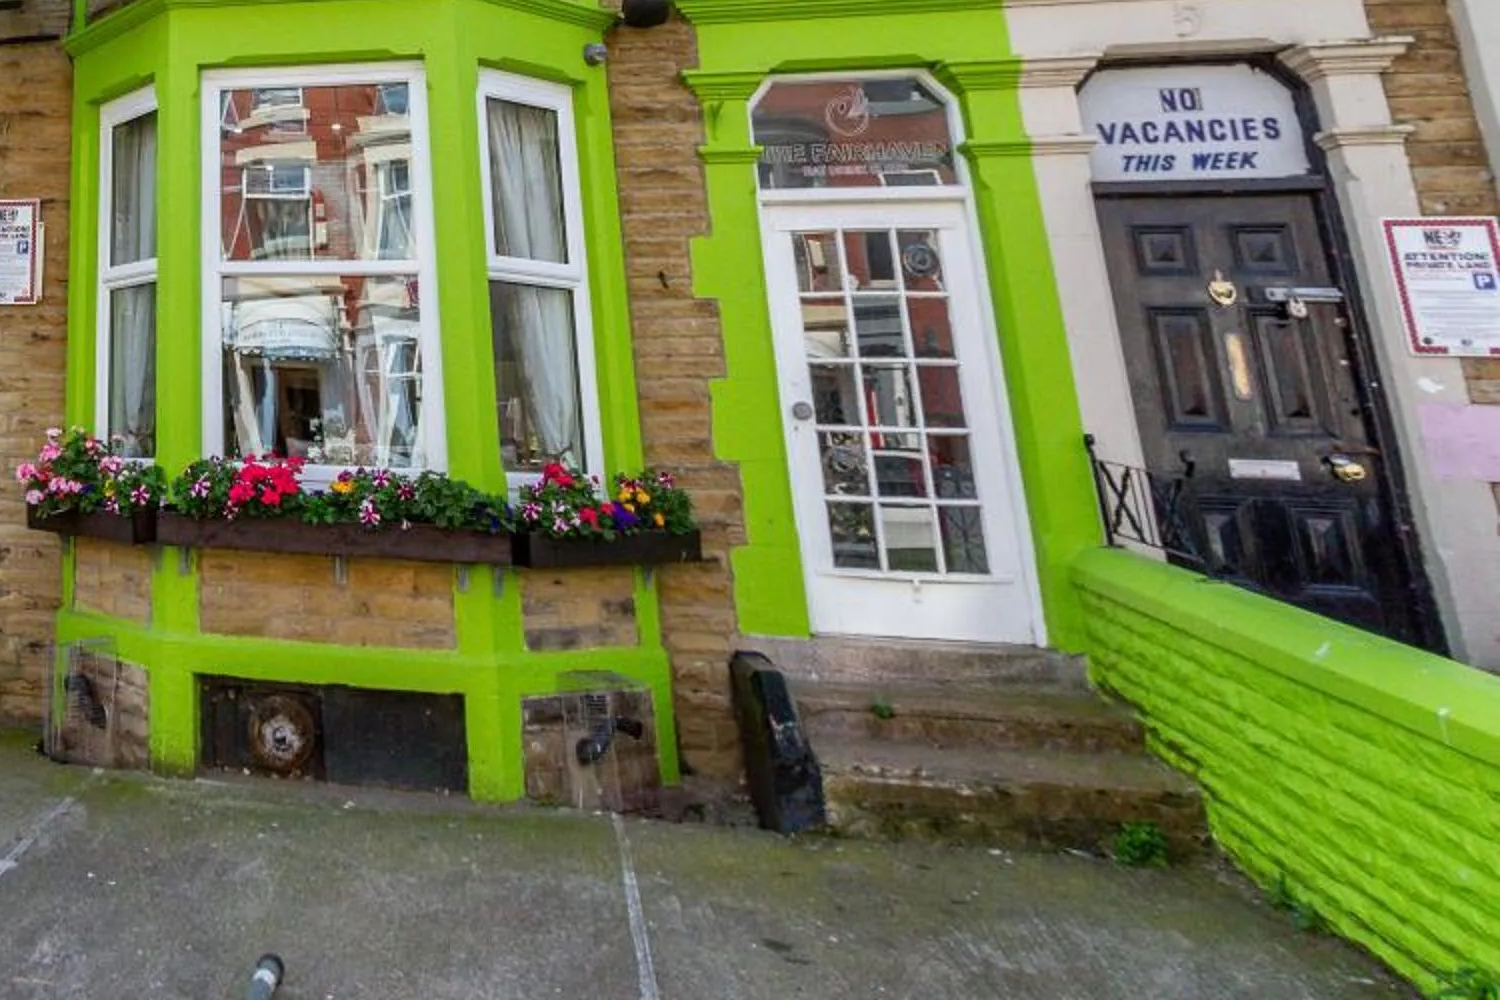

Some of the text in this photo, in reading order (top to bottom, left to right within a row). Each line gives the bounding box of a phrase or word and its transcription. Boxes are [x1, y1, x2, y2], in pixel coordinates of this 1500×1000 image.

[1159, 87, 1197, 113] NO
[1096, 116, 1281, 145] VACANCIES
[1122, 151, 1259, 172] THIS WEEK
